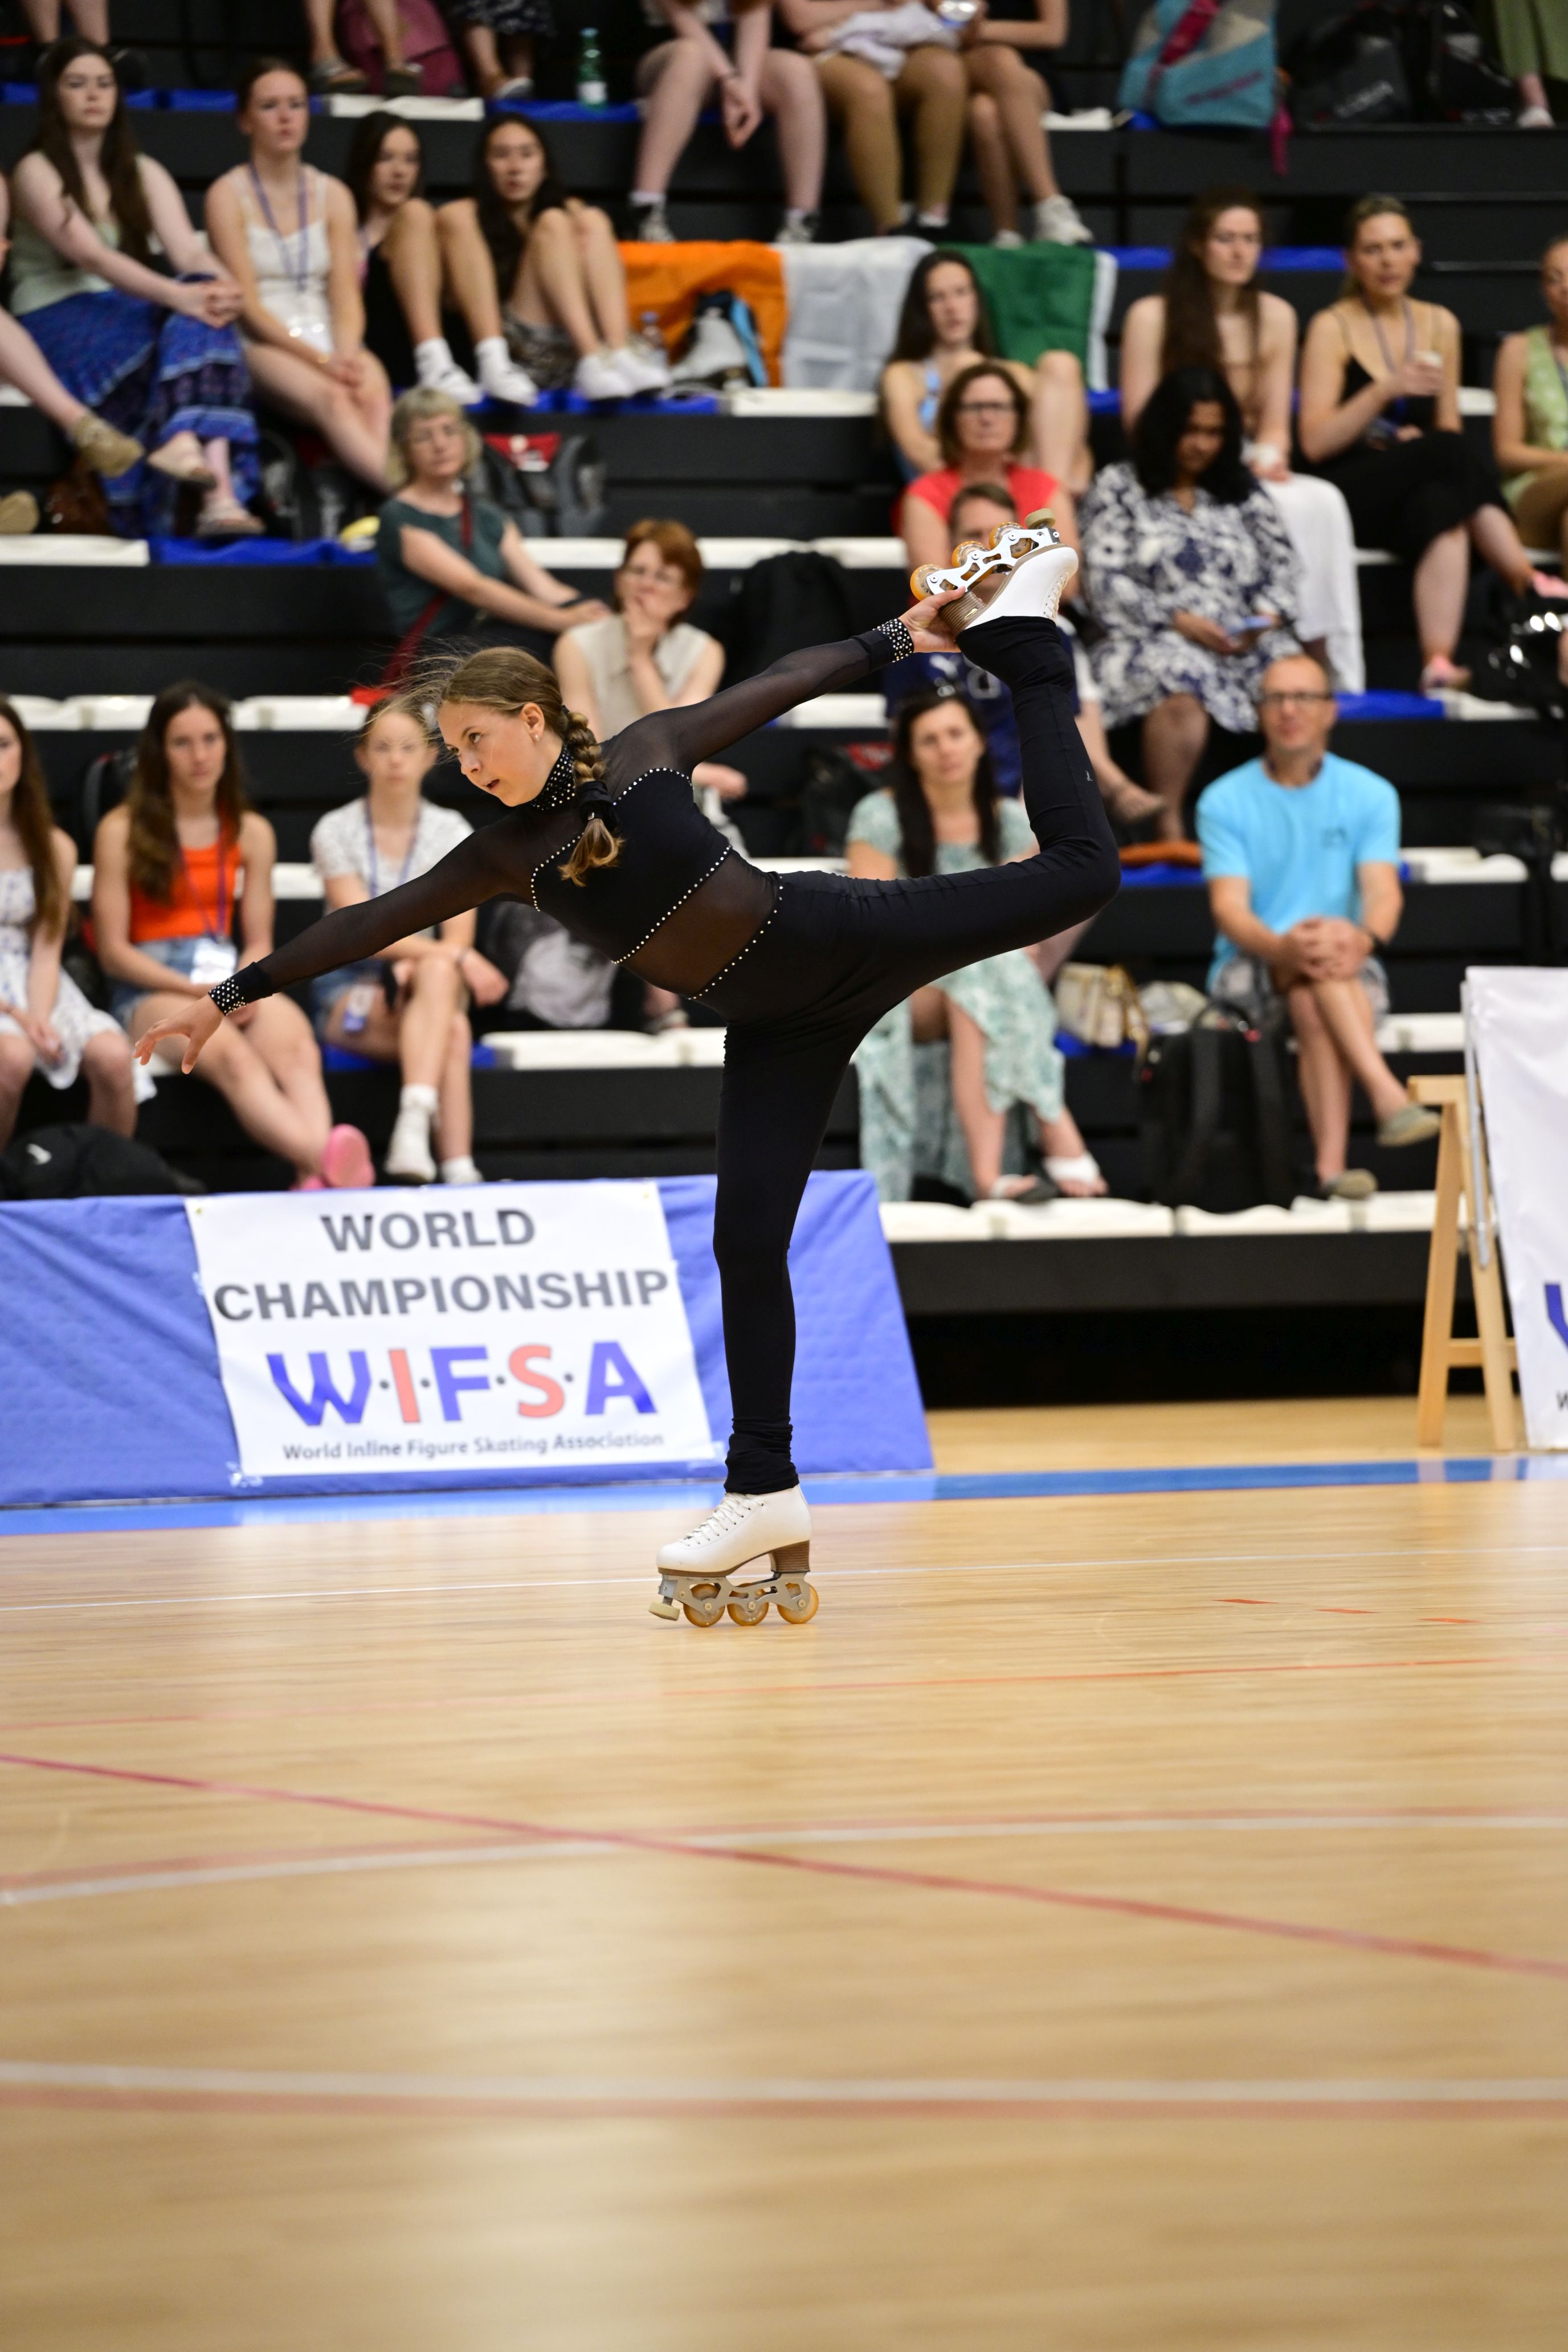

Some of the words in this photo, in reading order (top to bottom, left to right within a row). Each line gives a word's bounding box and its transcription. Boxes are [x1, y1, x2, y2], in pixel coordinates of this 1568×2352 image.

[320, 1208, 535, 1252] WORLD
[213, 1270, 668, 1321] CHAMPIONSHIP
[283, 1443, 341, 1460] World
[347, 1440, 402, 1459] Inline
[407, 1439, 468, 1459] Figure
[473, 1435, 549, 1456] Skating
[552, 1431, 665, 1450] Association
